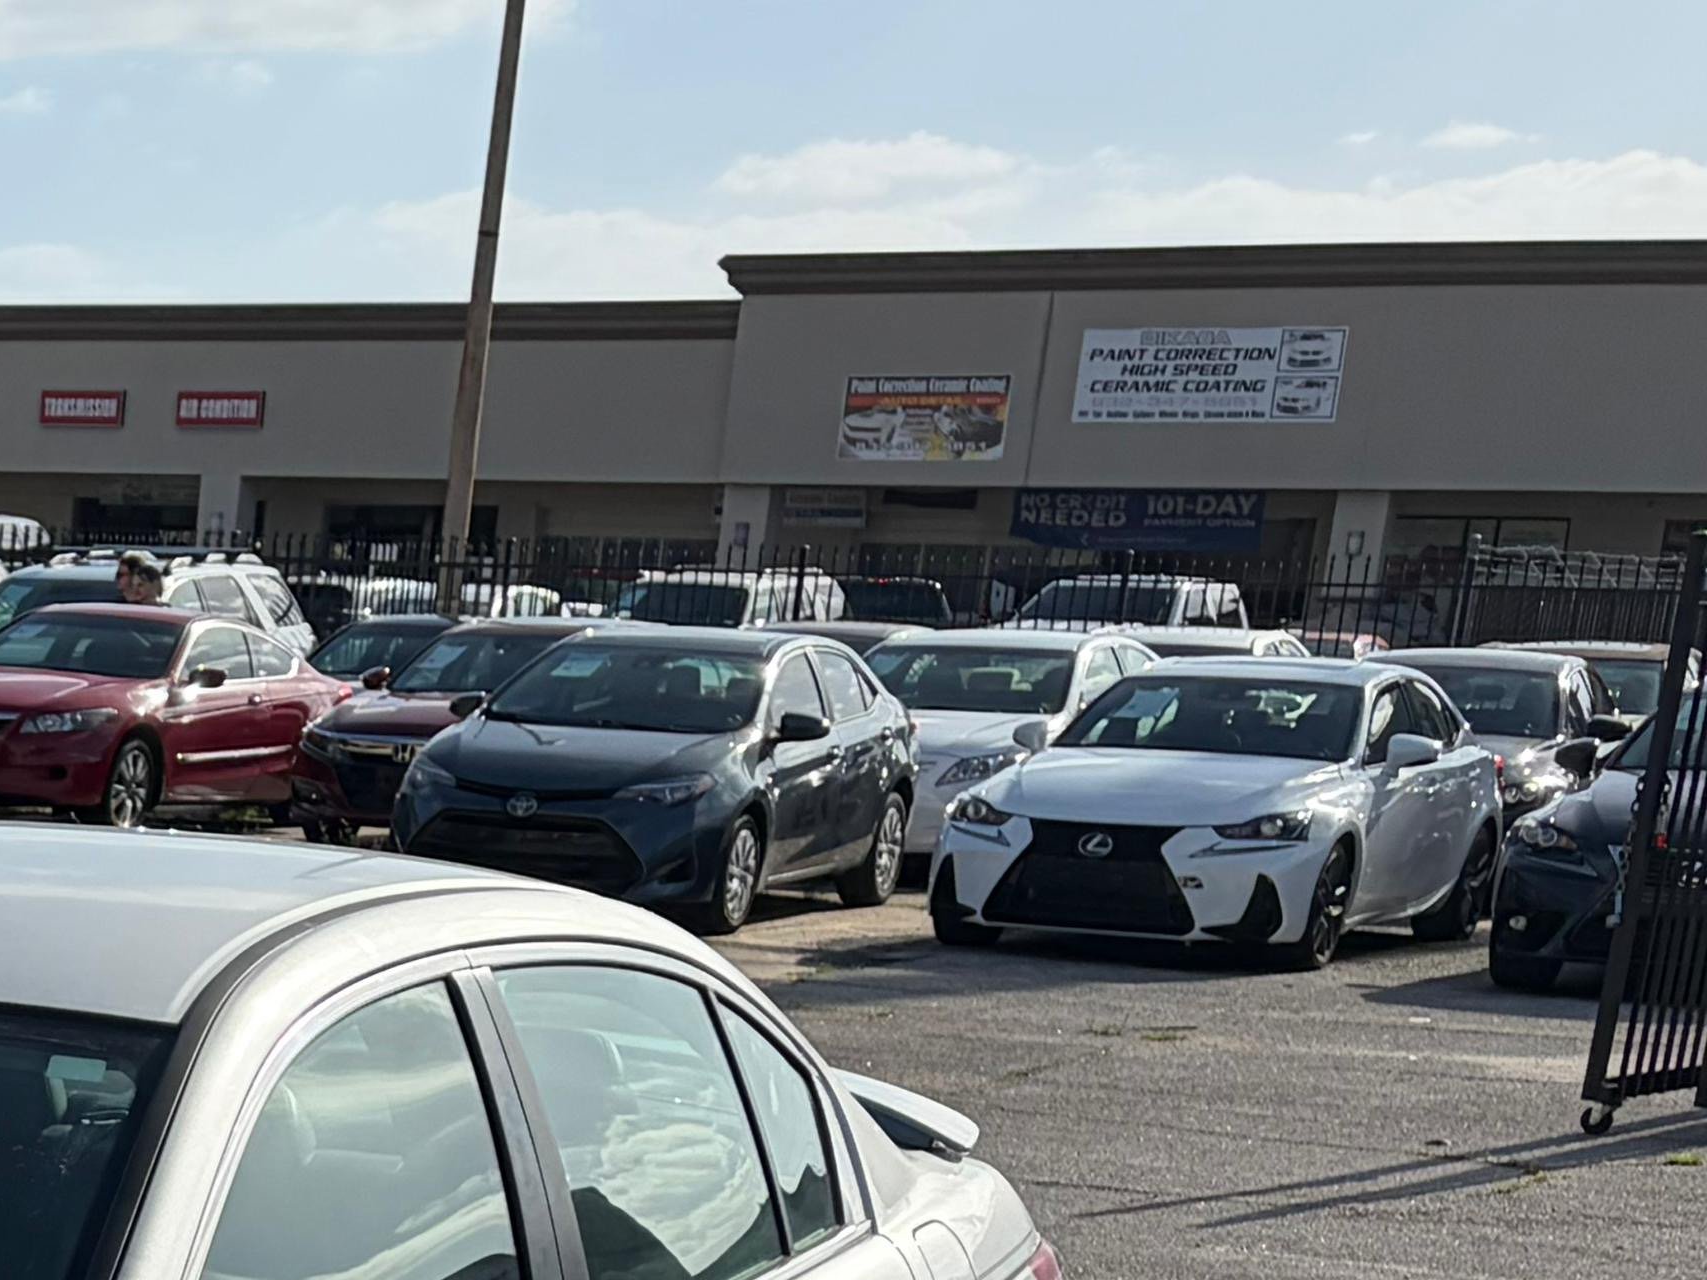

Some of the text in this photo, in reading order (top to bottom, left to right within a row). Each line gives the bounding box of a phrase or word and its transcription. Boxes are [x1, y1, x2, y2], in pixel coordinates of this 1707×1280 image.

[1089, 347, 1277, 362] PAINT CORRECTION
[1120, 363, 1238, 377] HIGH SPEED
[1089, 379, 1267, 394] CERAMIC COATING
[44, 397, 118, 417] TRANSMISSION
[178, 398, 199, 418] AIR
[1020, 493, 1051, 509] NO
[1146, 494, 1258, 516] 101-DAY
[1019, 508, 1128, 528] NEEDED
